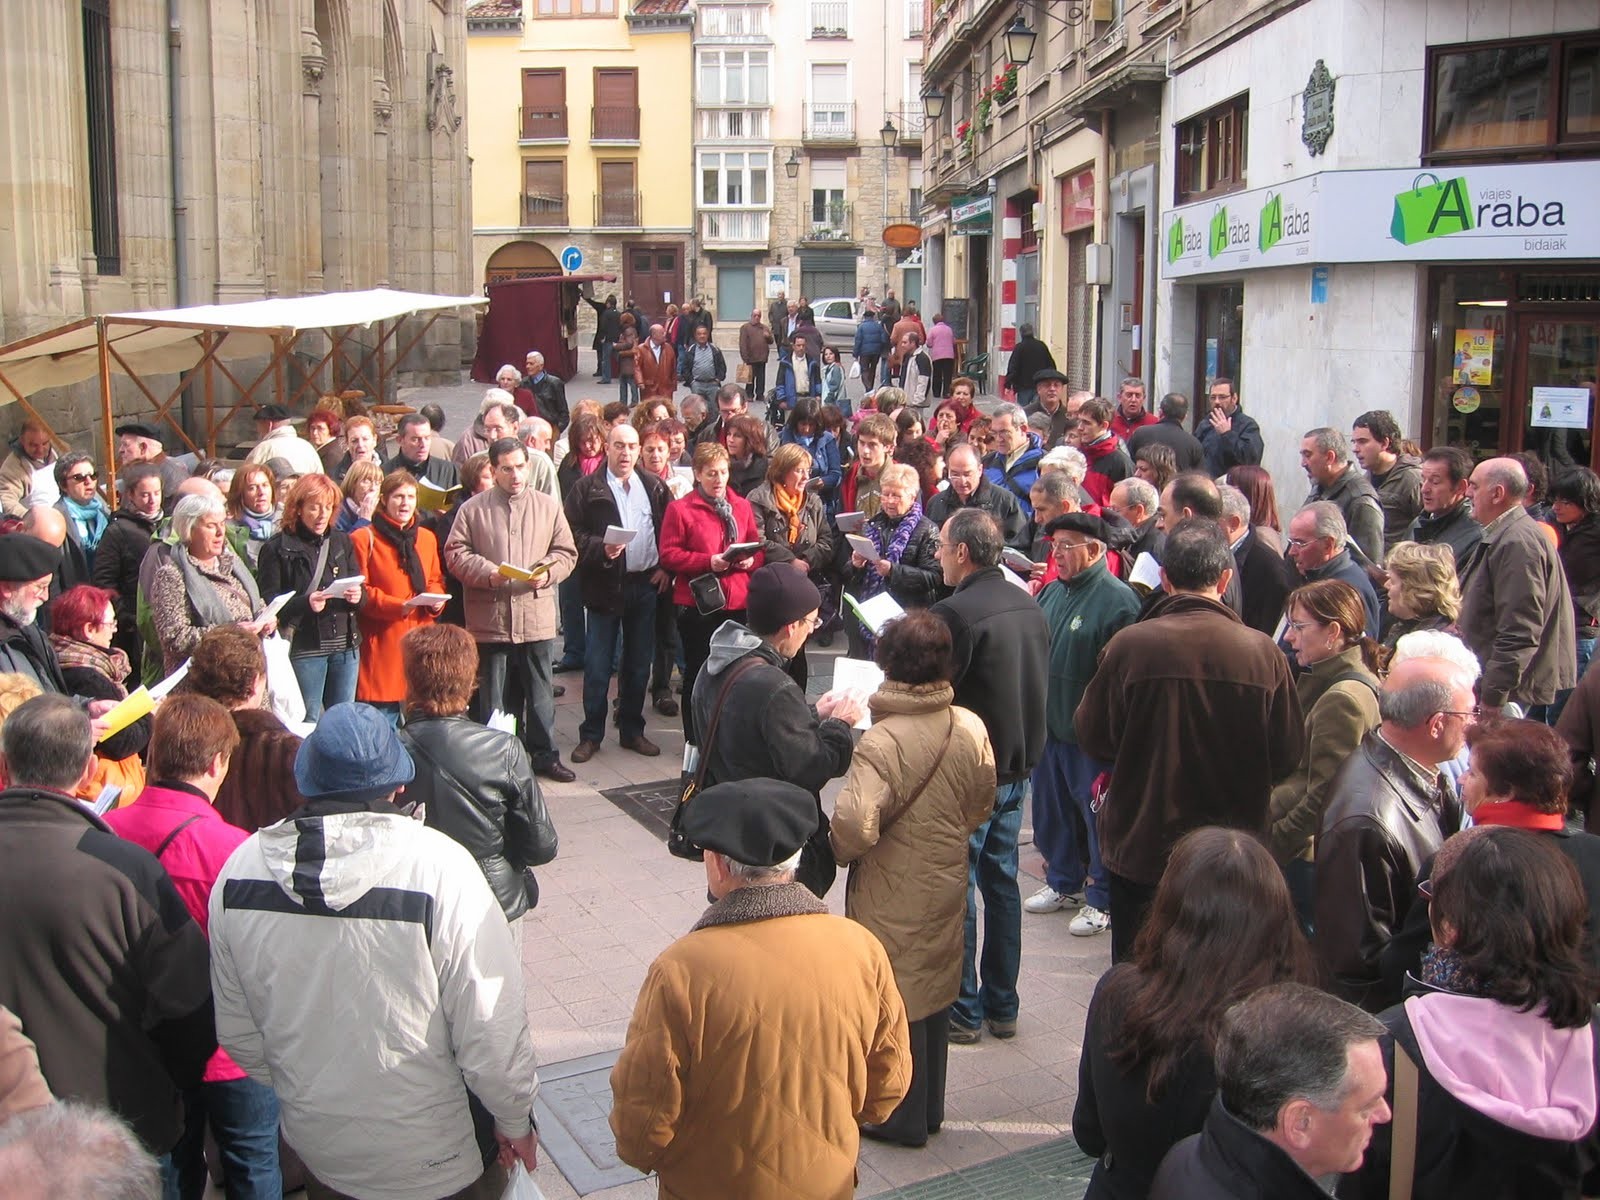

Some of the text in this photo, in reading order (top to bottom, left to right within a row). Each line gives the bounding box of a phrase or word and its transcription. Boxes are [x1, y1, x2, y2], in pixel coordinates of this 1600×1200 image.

[1427, 178, 1565, 233] Araba
[1480, 189, 1512, 203] viajes
[1174, 216, 1202, 257] Araba
[1216, 206, 1250, 251] Araba
[1268, 194, 1310, 244] Araba
[1524, 238, 1567, 251] bidaiak
